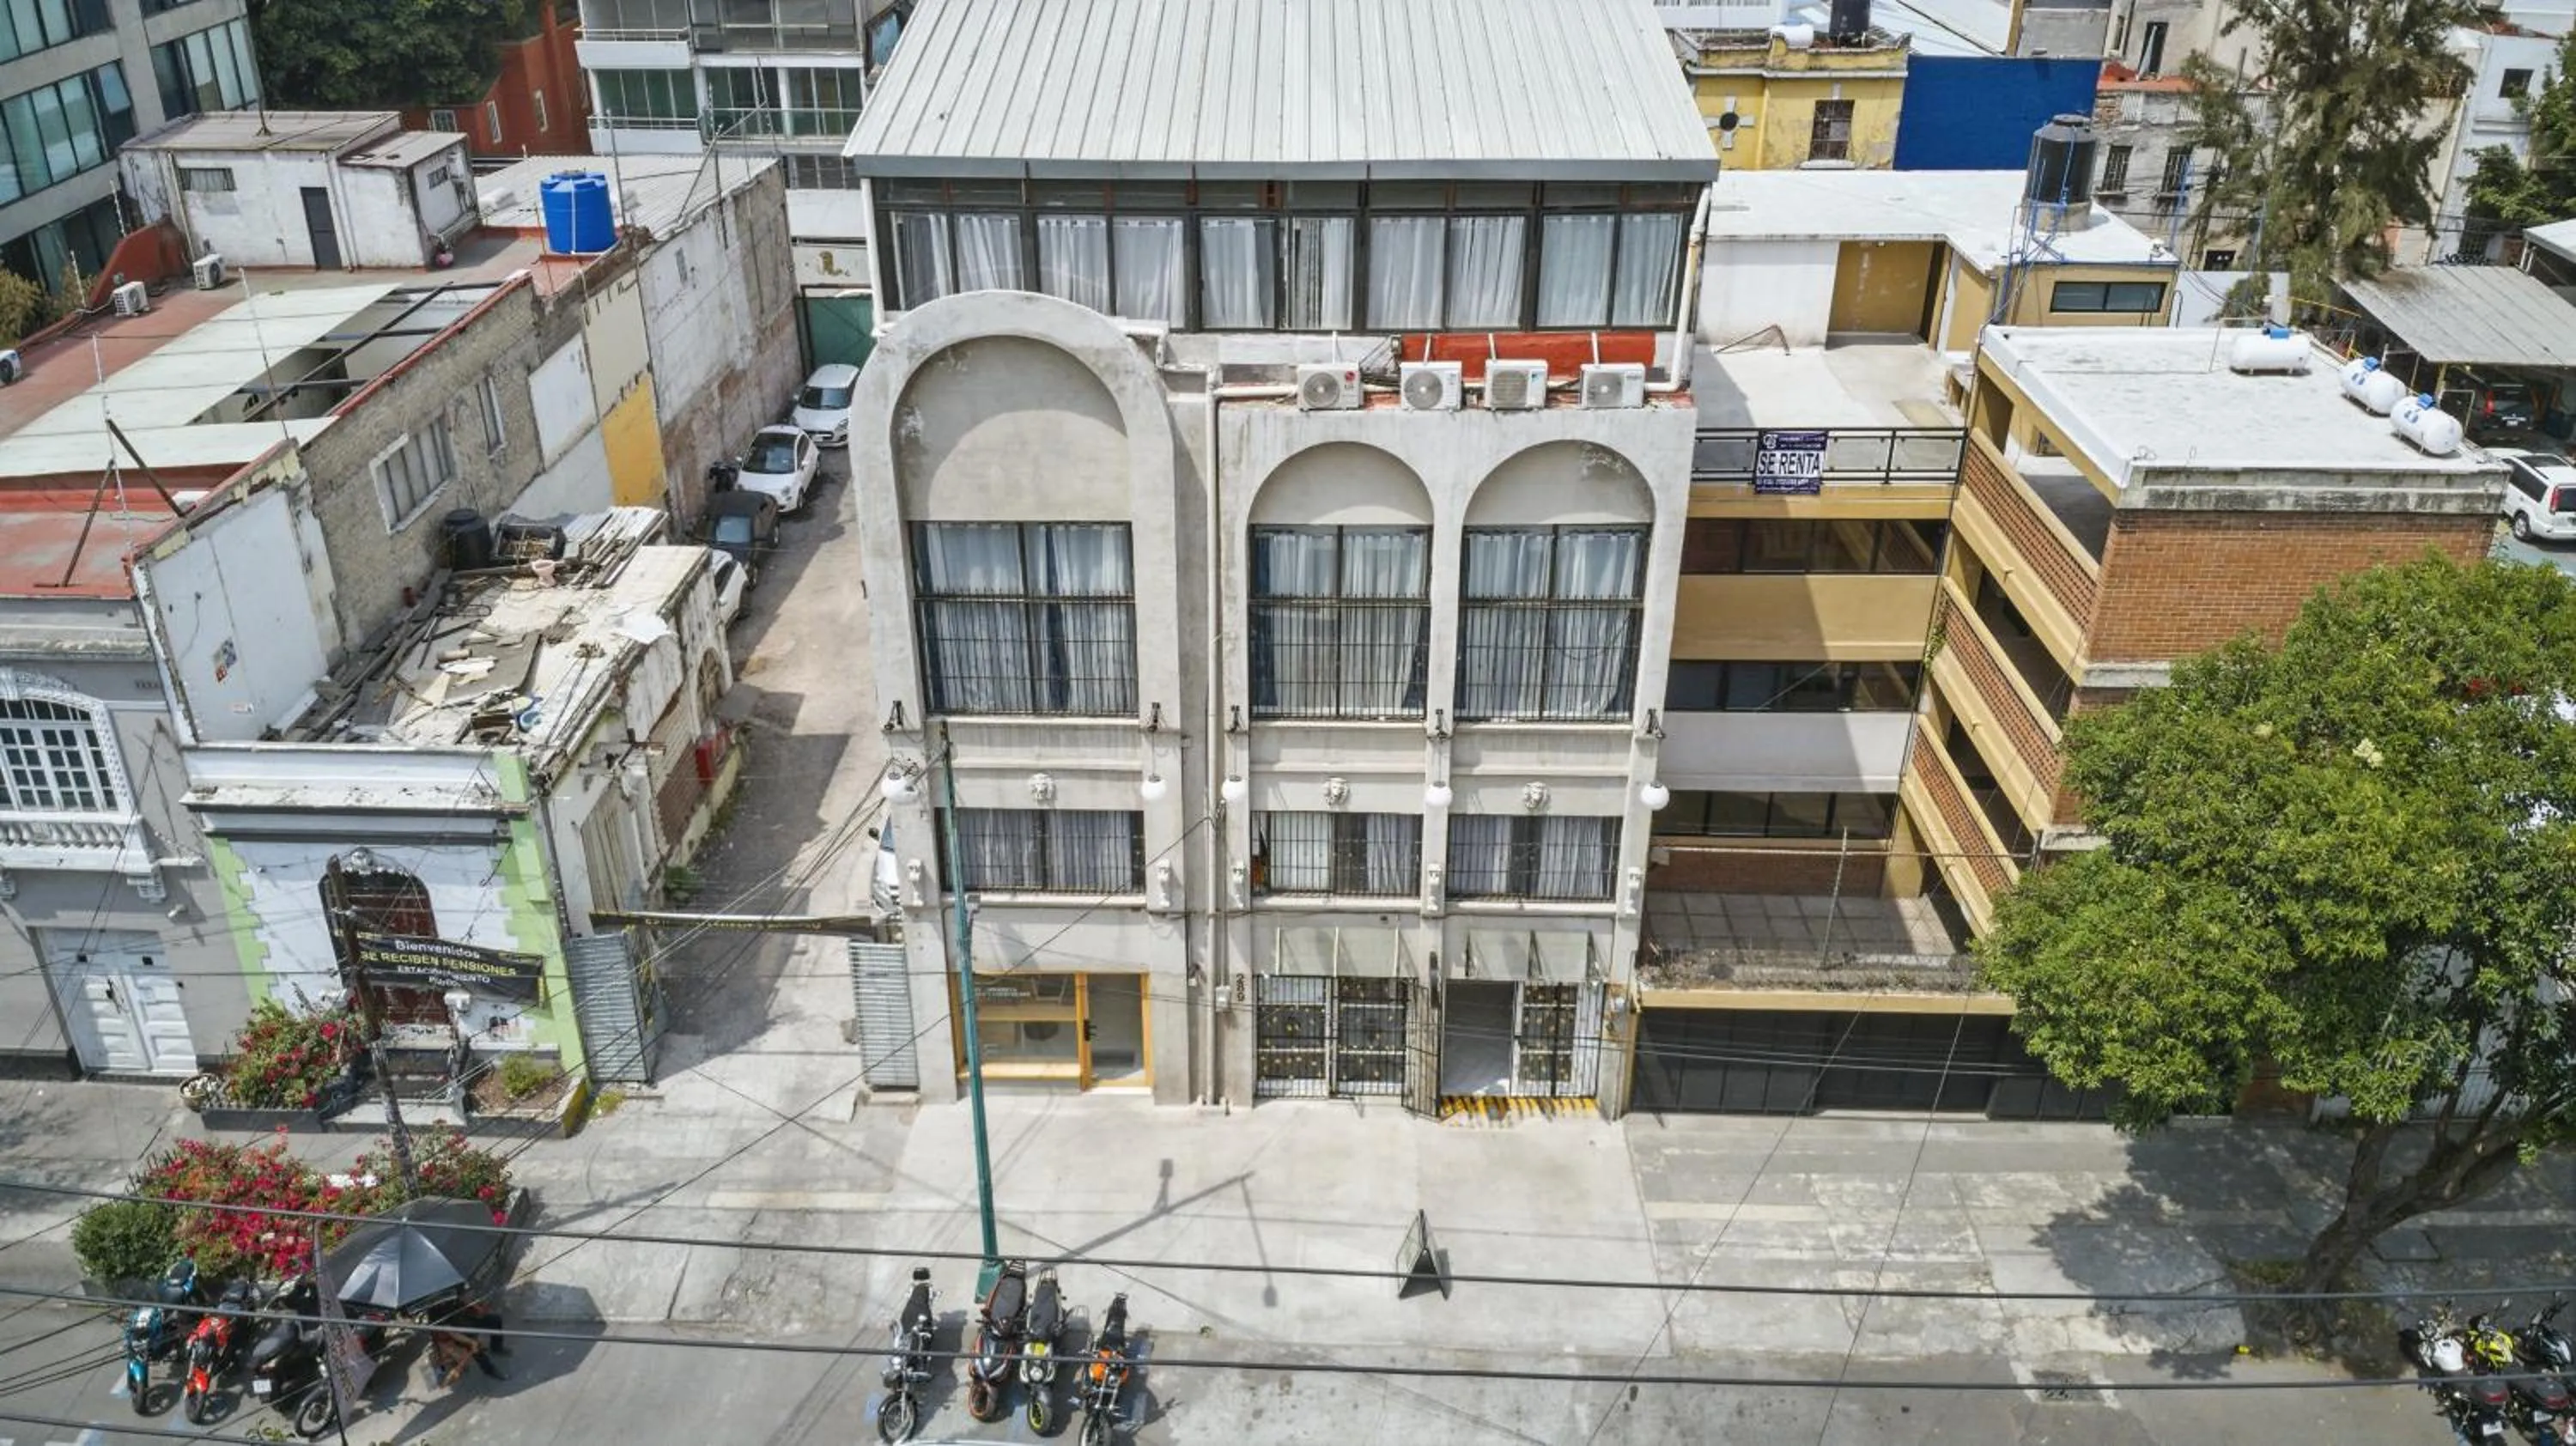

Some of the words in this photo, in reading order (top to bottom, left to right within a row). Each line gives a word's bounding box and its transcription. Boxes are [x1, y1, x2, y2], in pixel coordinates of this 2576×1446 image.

[1759, 453, 1777, 475] SE
[1778, 453, 1820, 475] RENTA
[380, 952, 439, 966] RECIBEN
[396, 940, 480, 959] Bienvenidos
